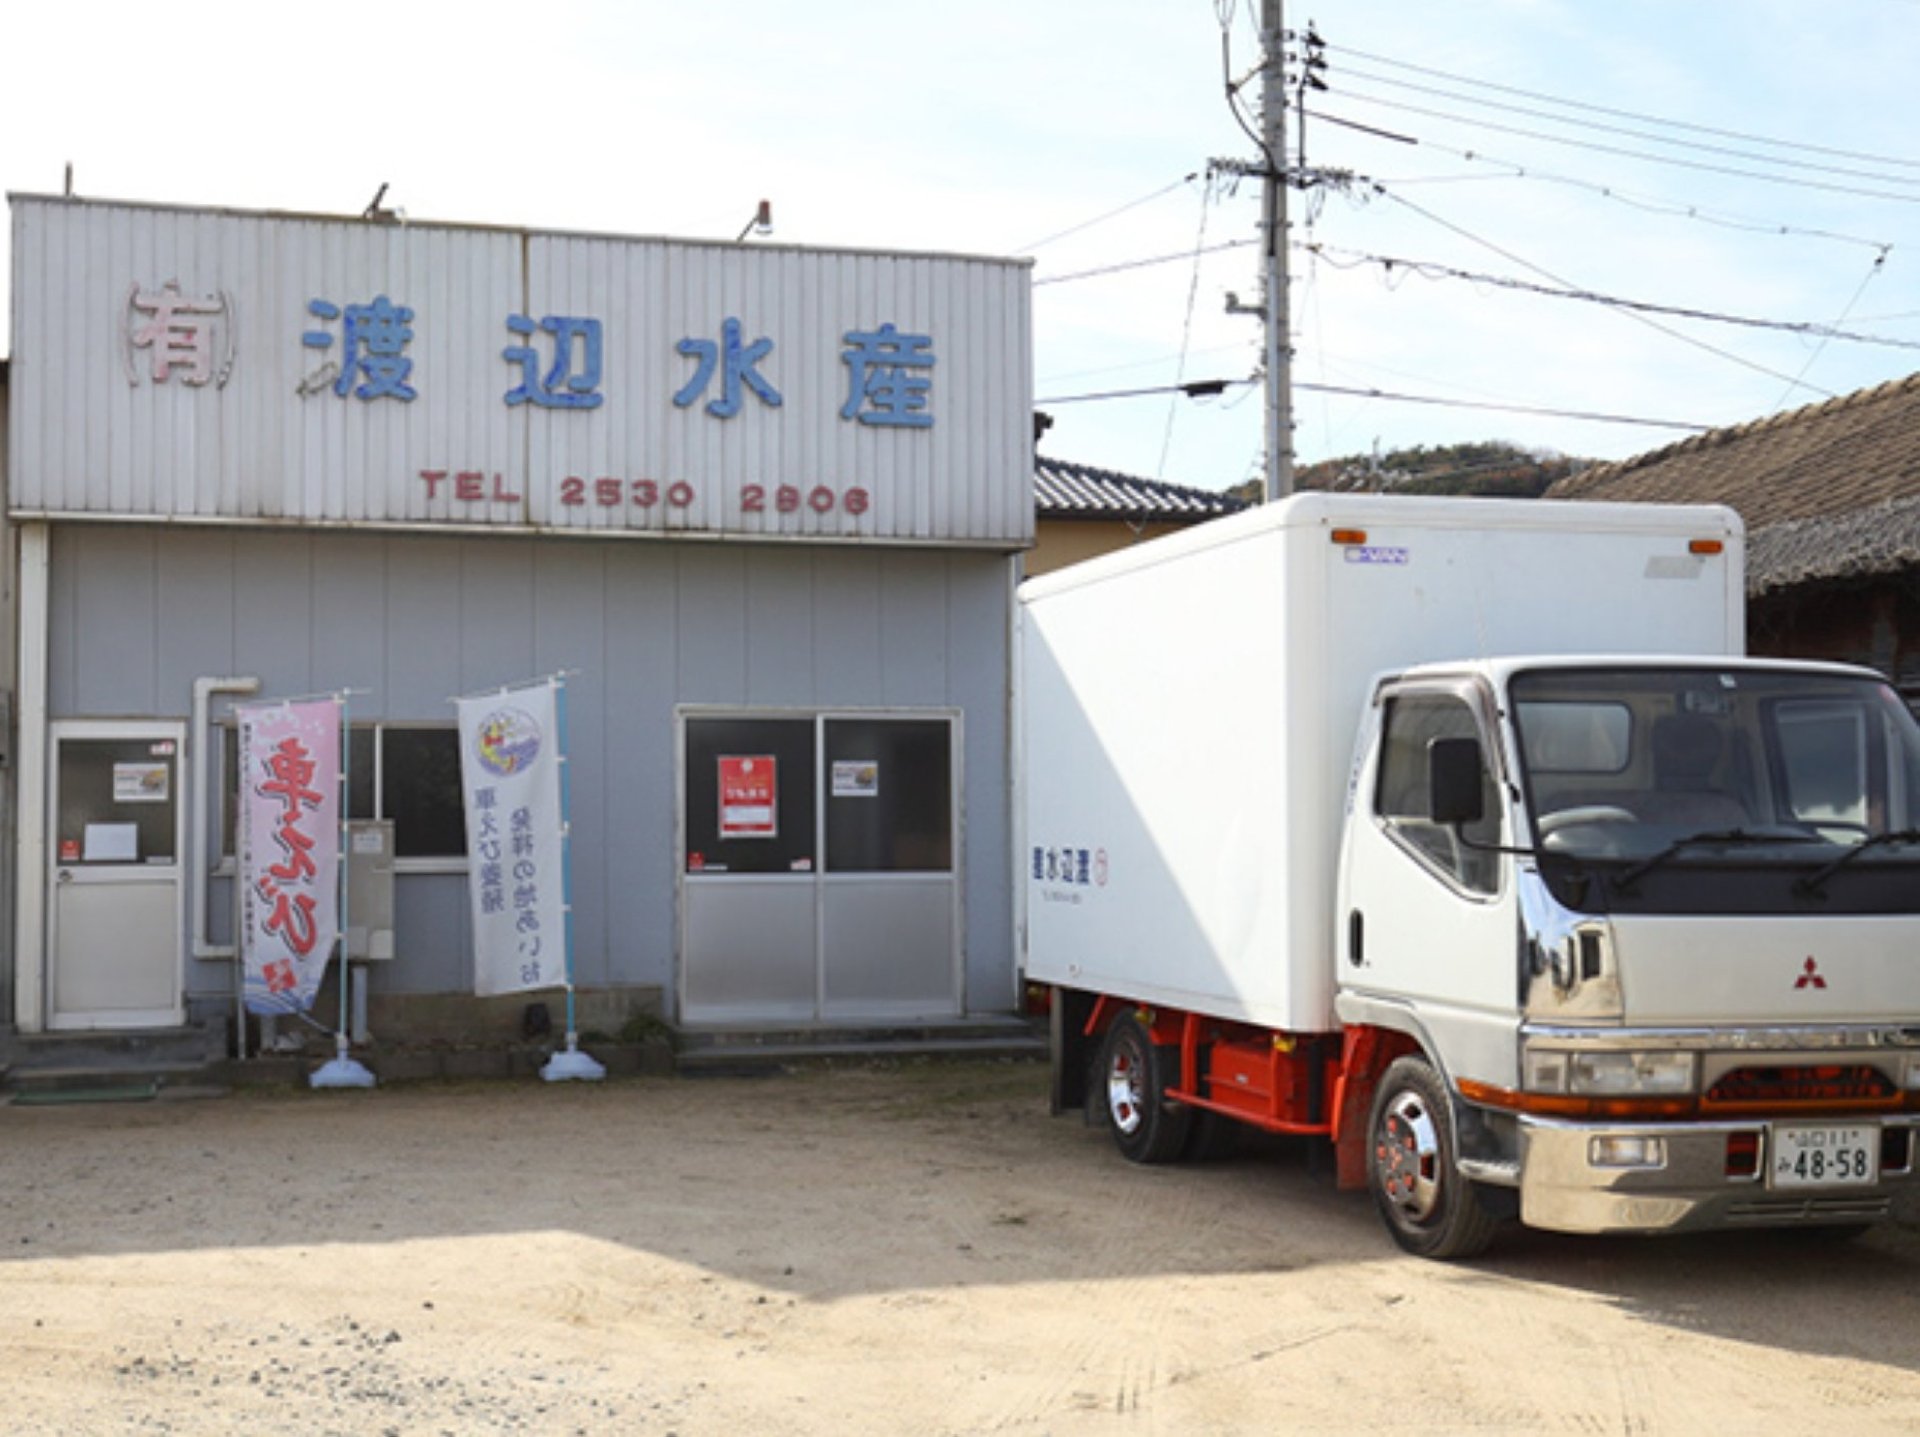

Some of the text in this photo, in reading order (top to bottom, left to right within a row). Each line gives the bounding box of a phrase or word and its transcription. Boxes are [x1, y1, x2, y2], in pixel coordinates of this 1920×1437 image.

[420, 470, 521, 503] TEL
[560, 476, 695, 509] 2530
[1794, 1148, 1866, 1179] 48-58
